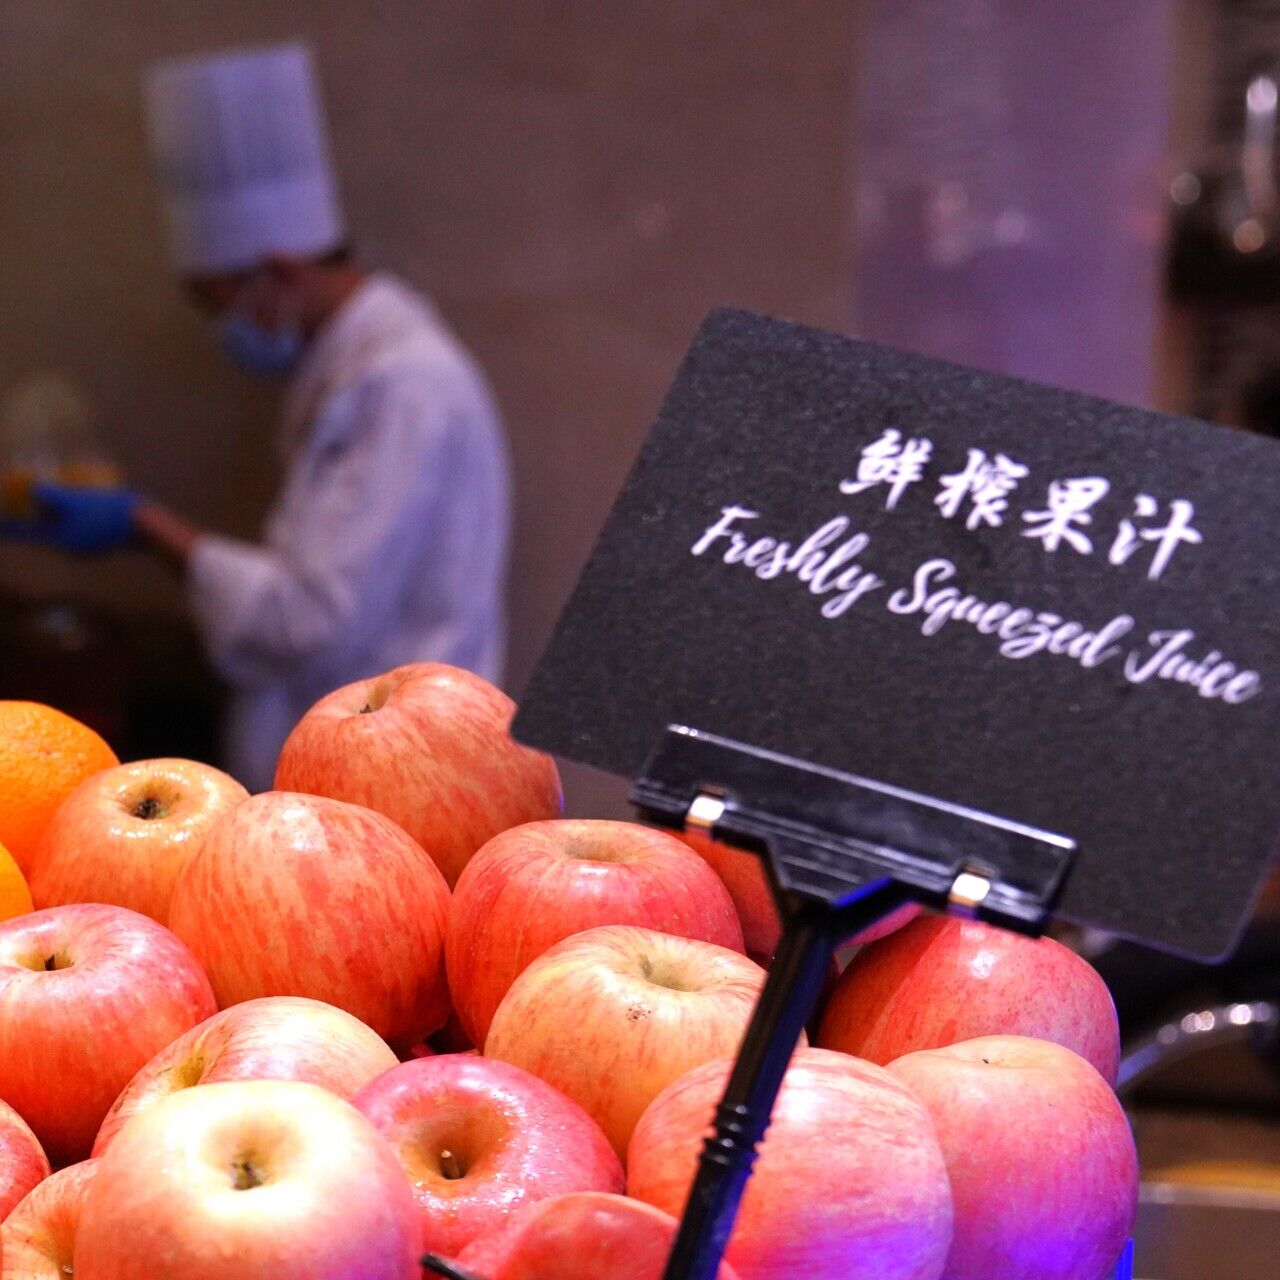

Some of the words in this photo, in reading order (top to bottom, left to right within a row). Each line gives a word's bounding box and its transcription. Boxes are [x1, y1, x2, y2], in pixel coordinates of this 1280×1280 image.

[838, 427, 1204, 582] 鲜榨果汁
[690, 504, 886, 619] Freshly
[886, 558, 1135, 668] Squeezed
[1124, 629, 1263, 704] Juice
